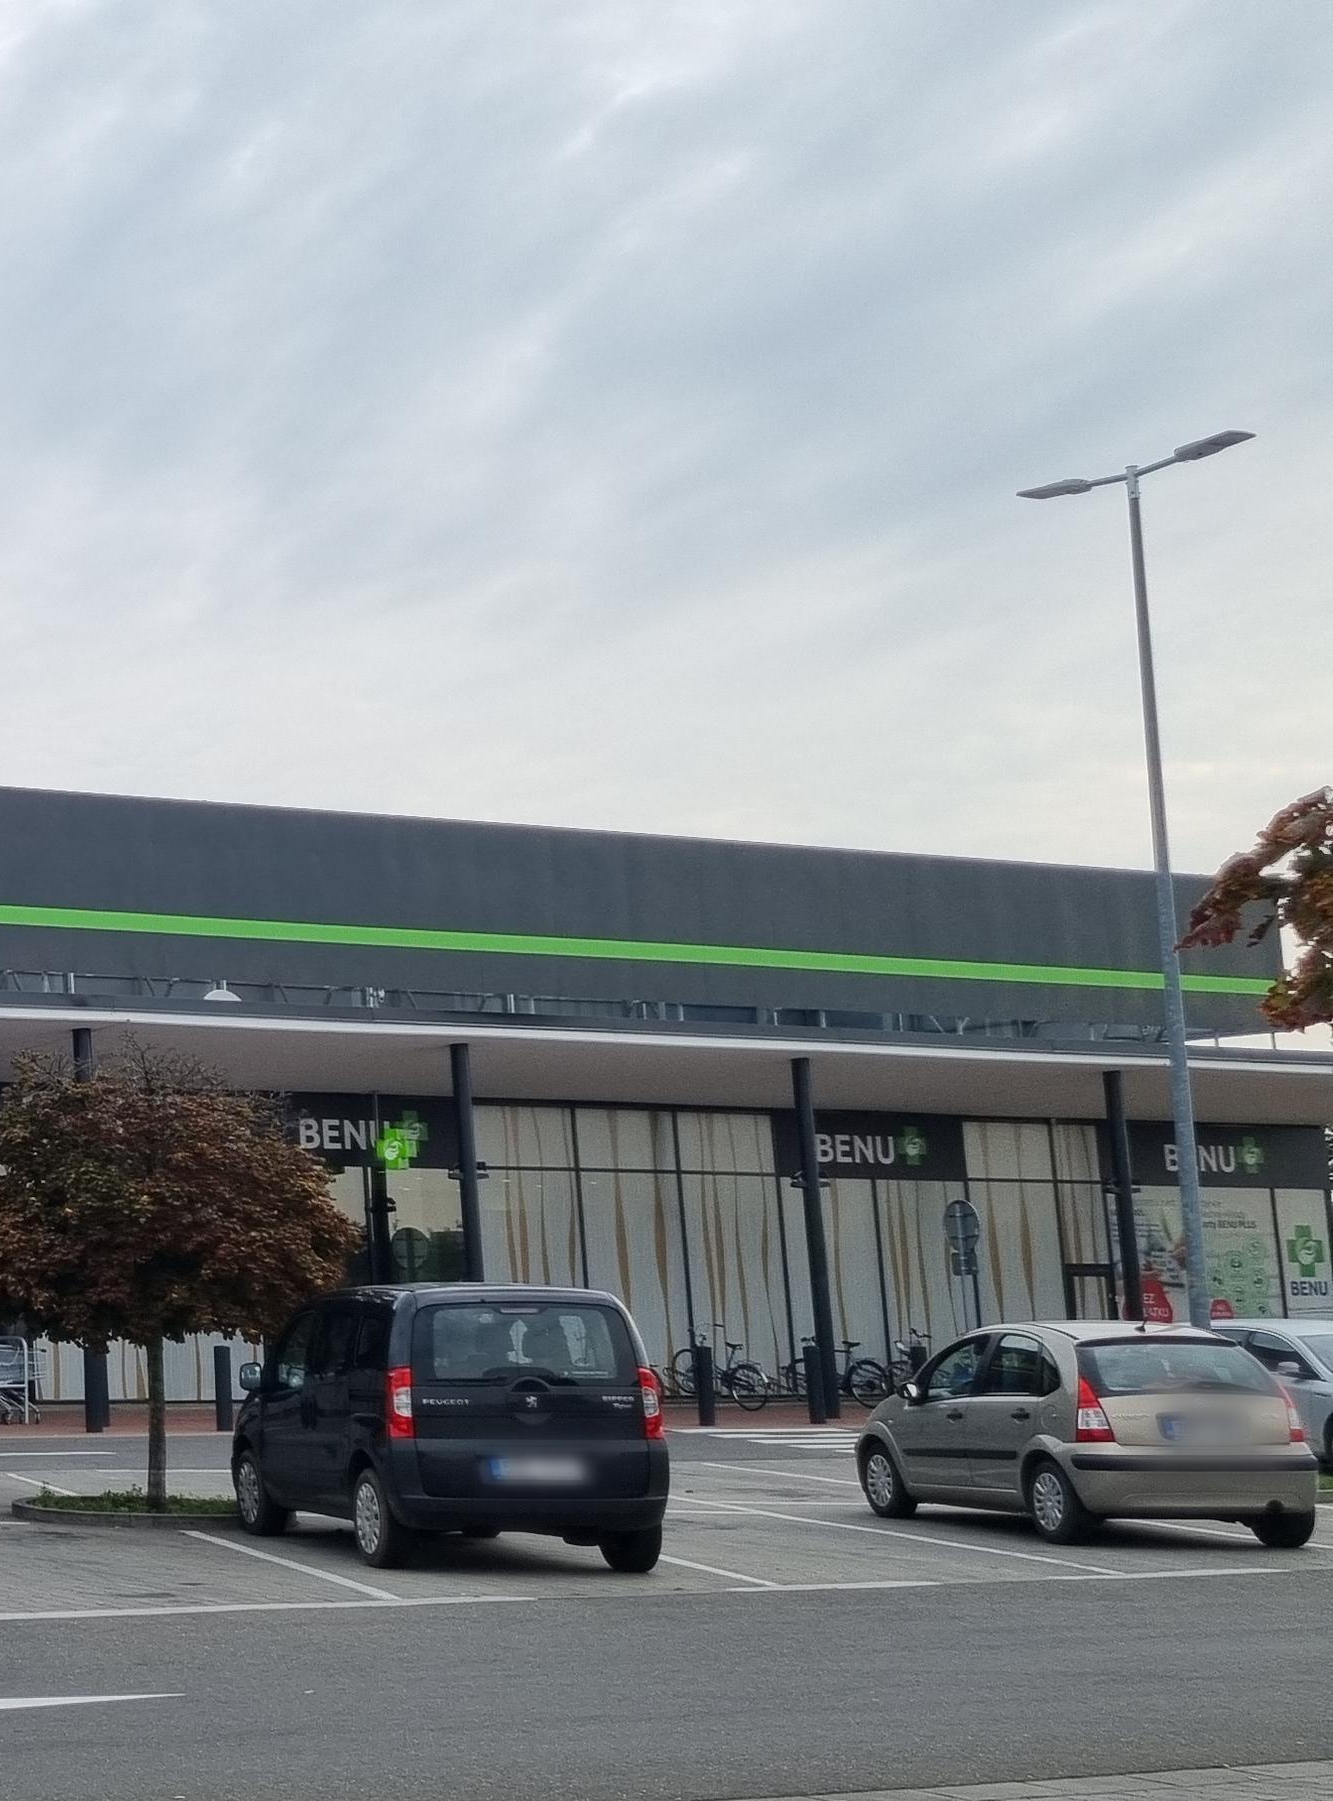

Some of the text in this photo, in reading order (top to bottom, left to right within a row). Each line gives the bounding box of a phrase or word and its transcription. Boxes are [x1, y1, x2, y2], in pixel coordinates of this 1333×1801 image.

[815, 1133, 895, 1164] BENU
[1163, 1143, 1236, 1173] BNU
[1290, 1280, 1329, 1297] BENU
